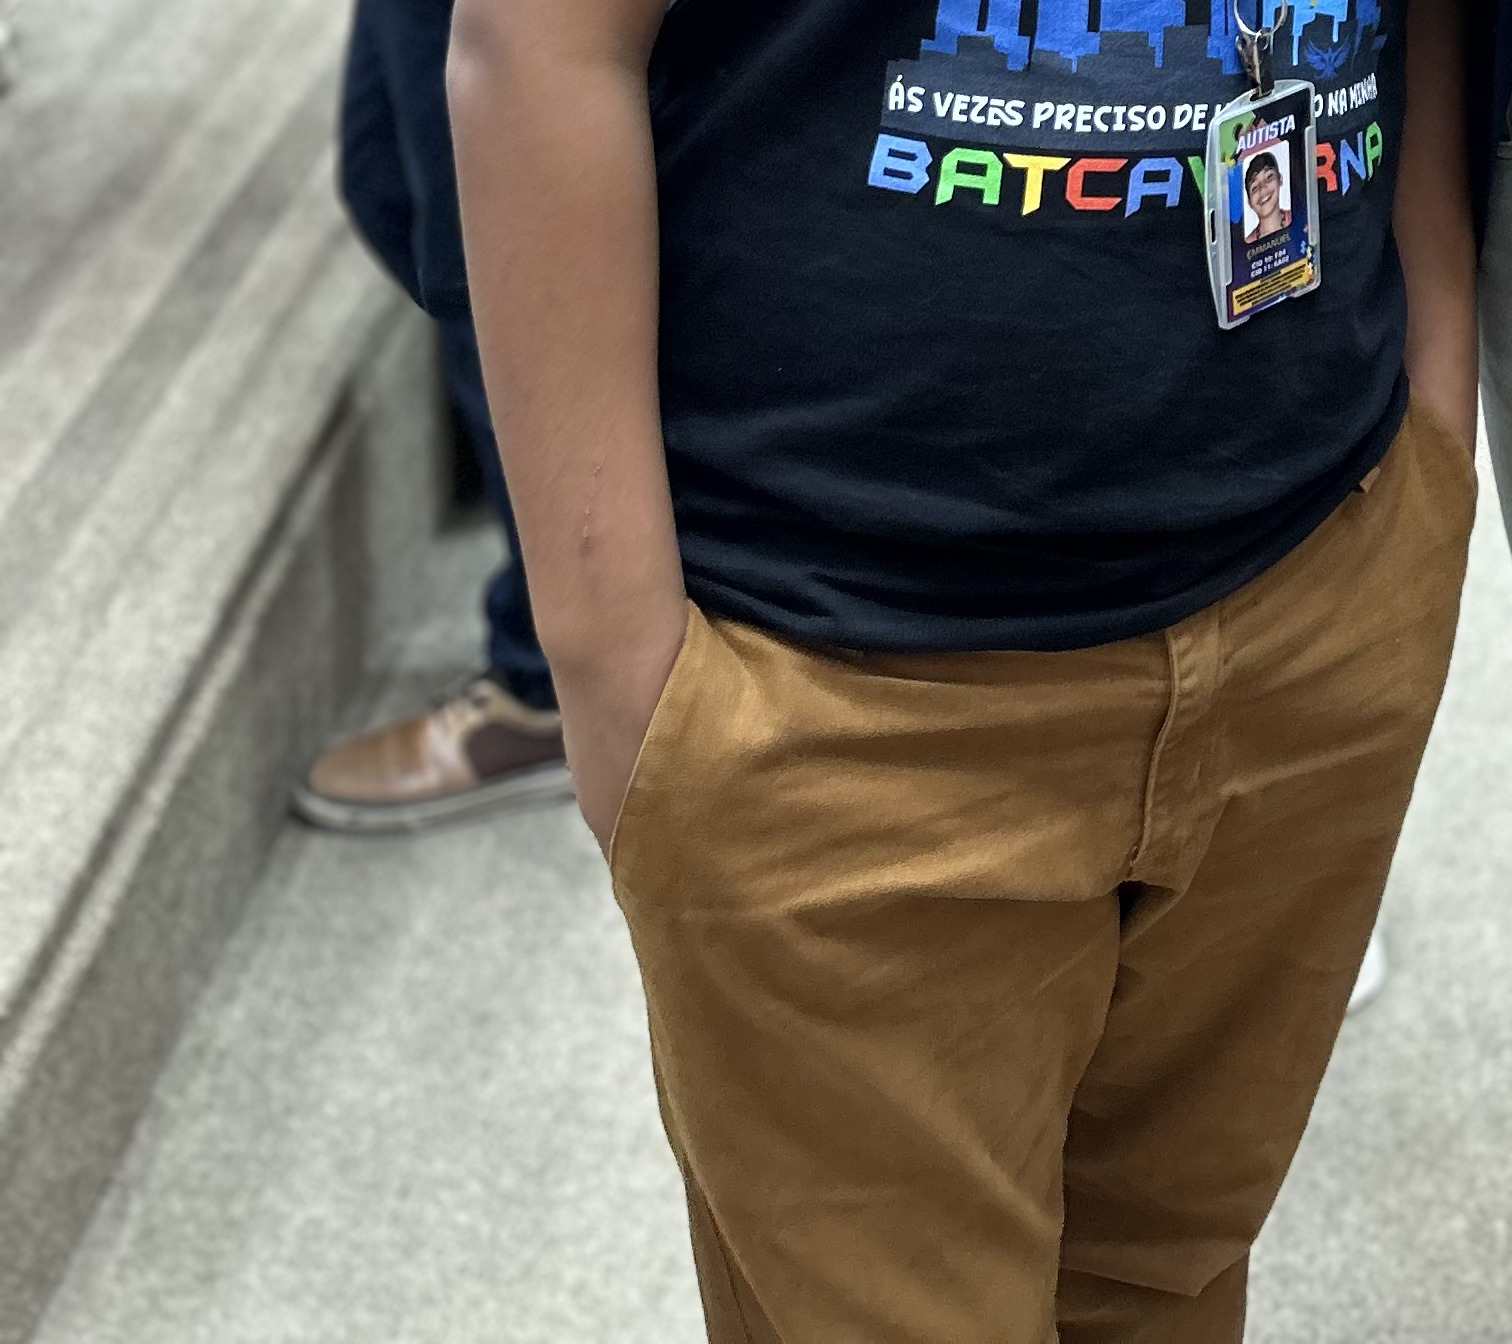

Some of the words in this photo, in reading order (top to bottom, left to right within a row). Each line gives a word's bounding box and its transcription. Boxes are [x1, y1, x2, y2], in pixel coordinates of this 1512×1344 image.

[932, 91, 1026, 126] VEZES
[1032, 101, 1167, 132] PRECISO
[1173, 103, 1209, 131] DE
[1327, 87, 1348, 117] NA
[1349, 72, 1378, 110] MINHA
[1236, 114, 1296, 154] AUTISTA
[867, 121, 1383, 219] BATCARNA
